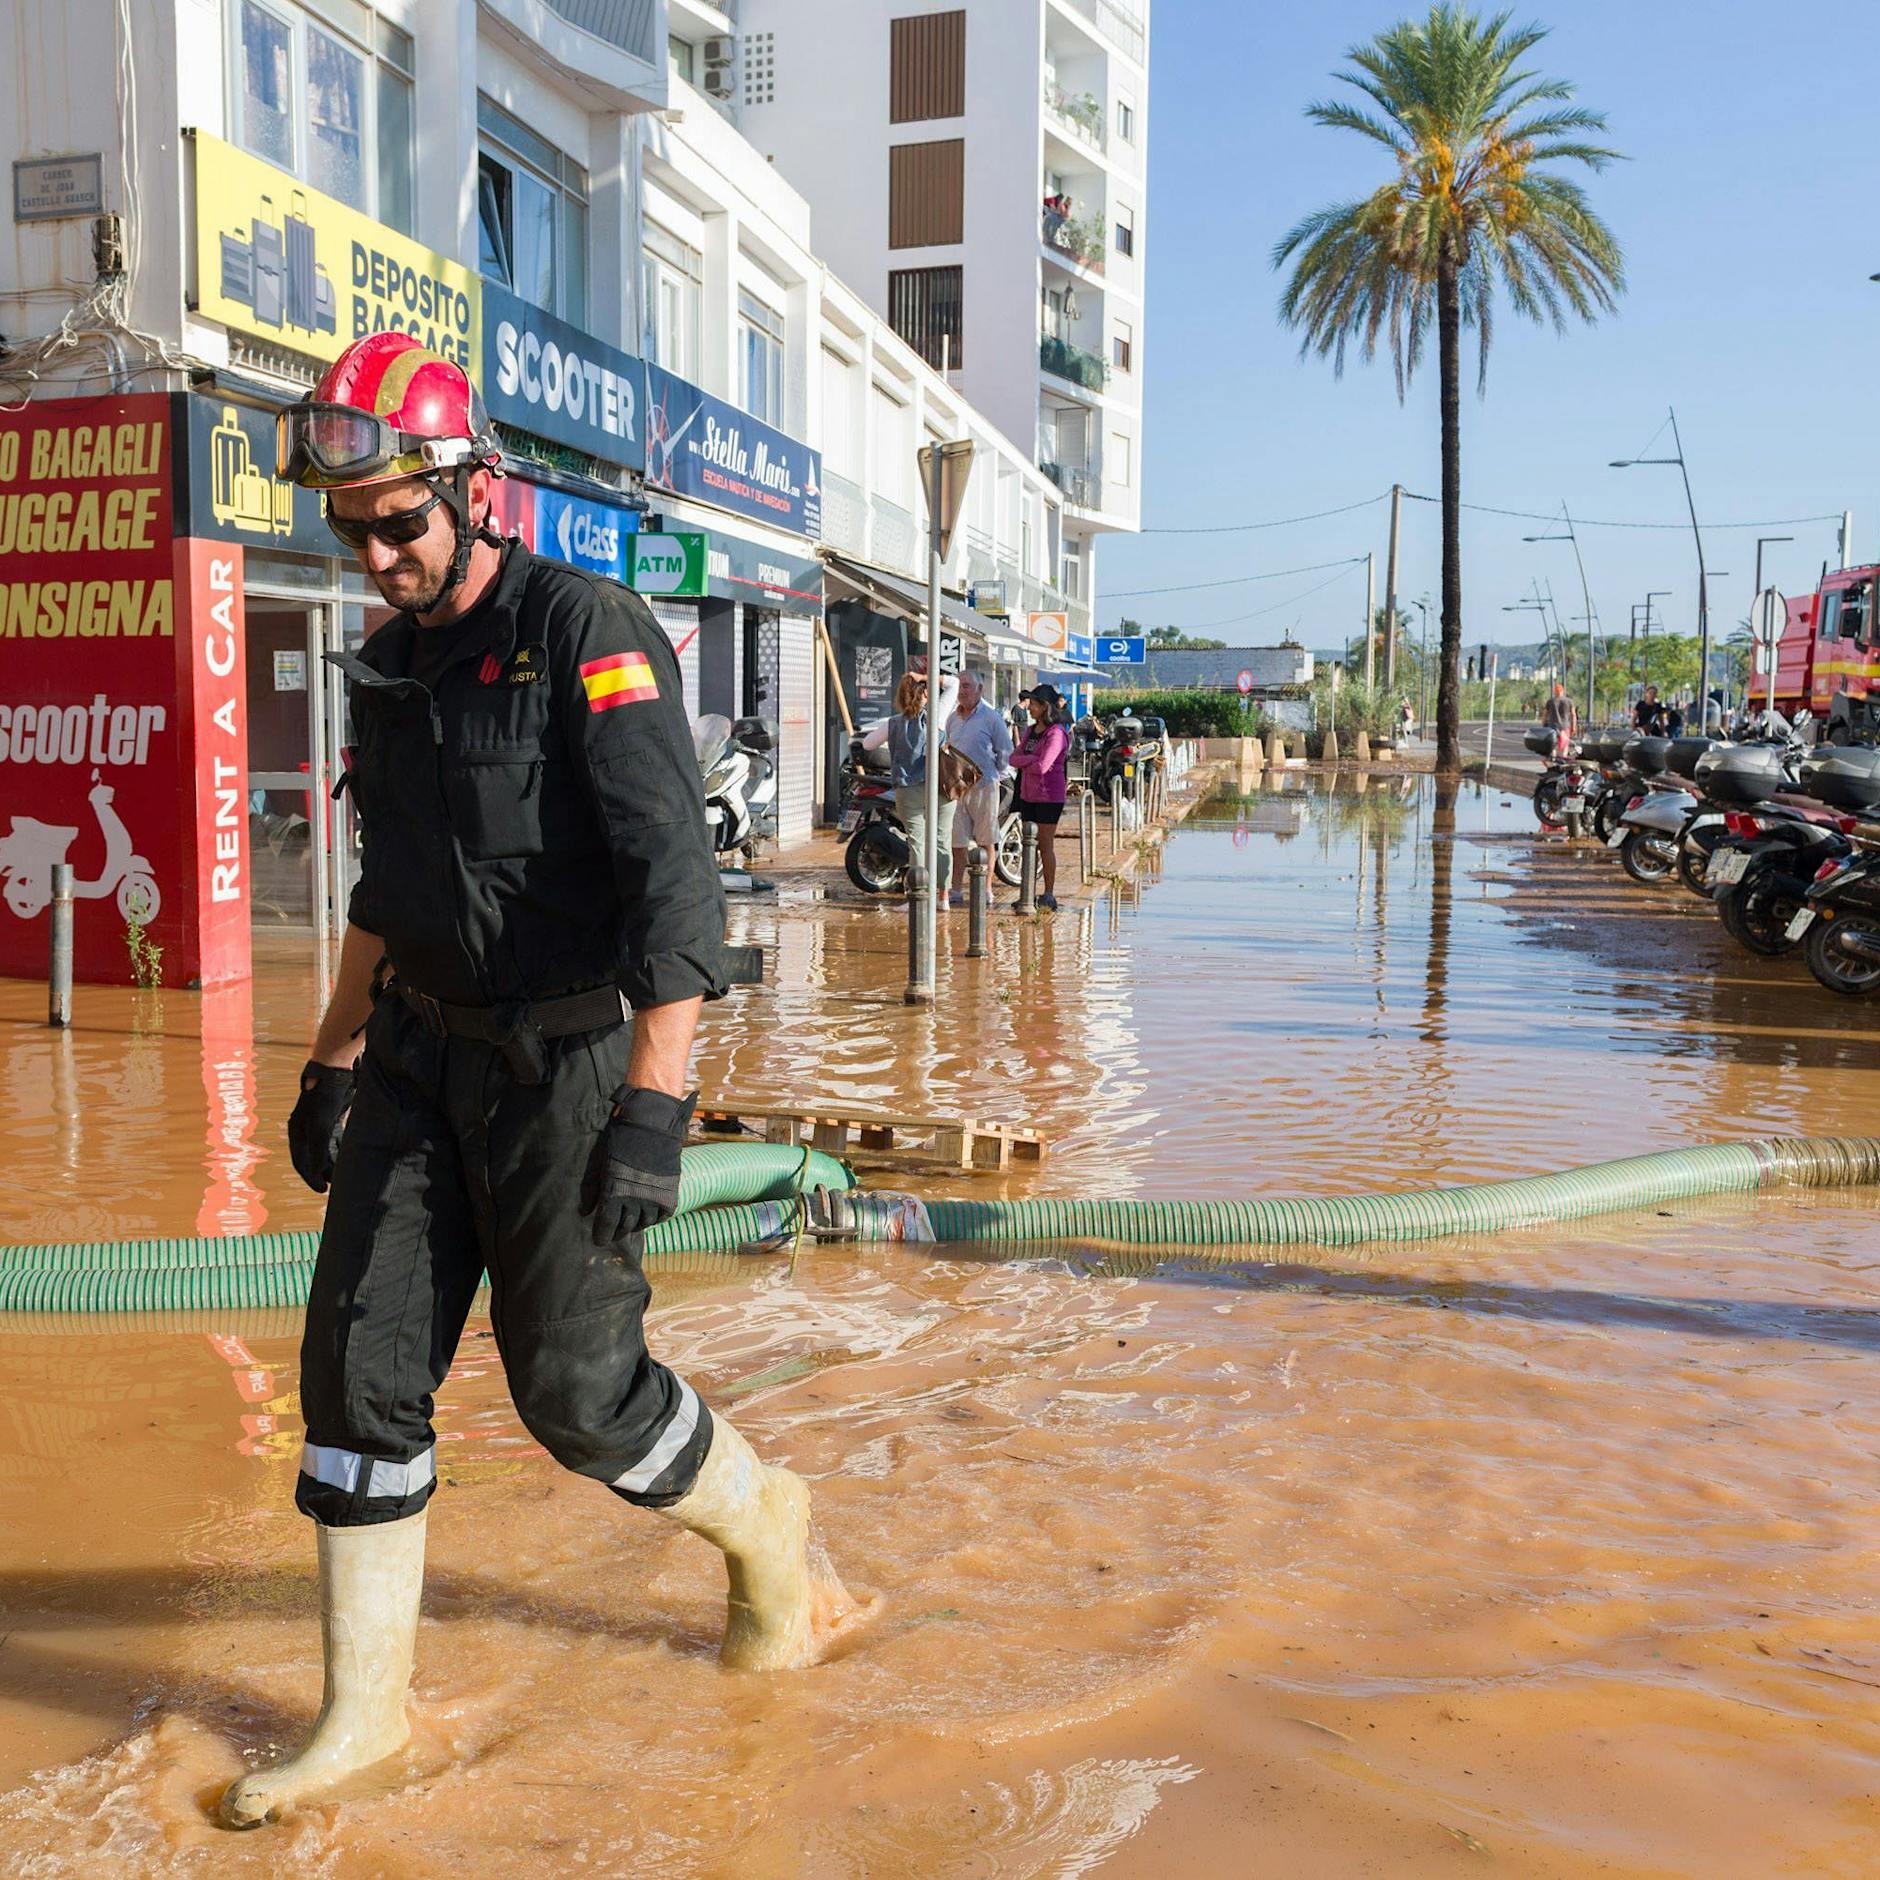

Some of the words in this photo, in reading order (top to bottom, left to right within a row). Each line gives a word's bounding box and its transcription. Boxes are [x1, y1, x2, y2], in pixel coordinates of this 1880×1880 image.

[352, 240, 469, 335] DEPOSITO
[496, 321, 635, 442] SCOOTER
[0, 431, 20, 482] O
[29, 422, 163, 480] BAGAGLI
[703, 468, 729, 491] ESCUELA
[574, 513, 619, 561] Class
[637, 556, 682, 573] ATM
[205, 559, 236, 677] CAR
[213, 697, 236, 736] A
[212, 756, 240, 903] RENT
